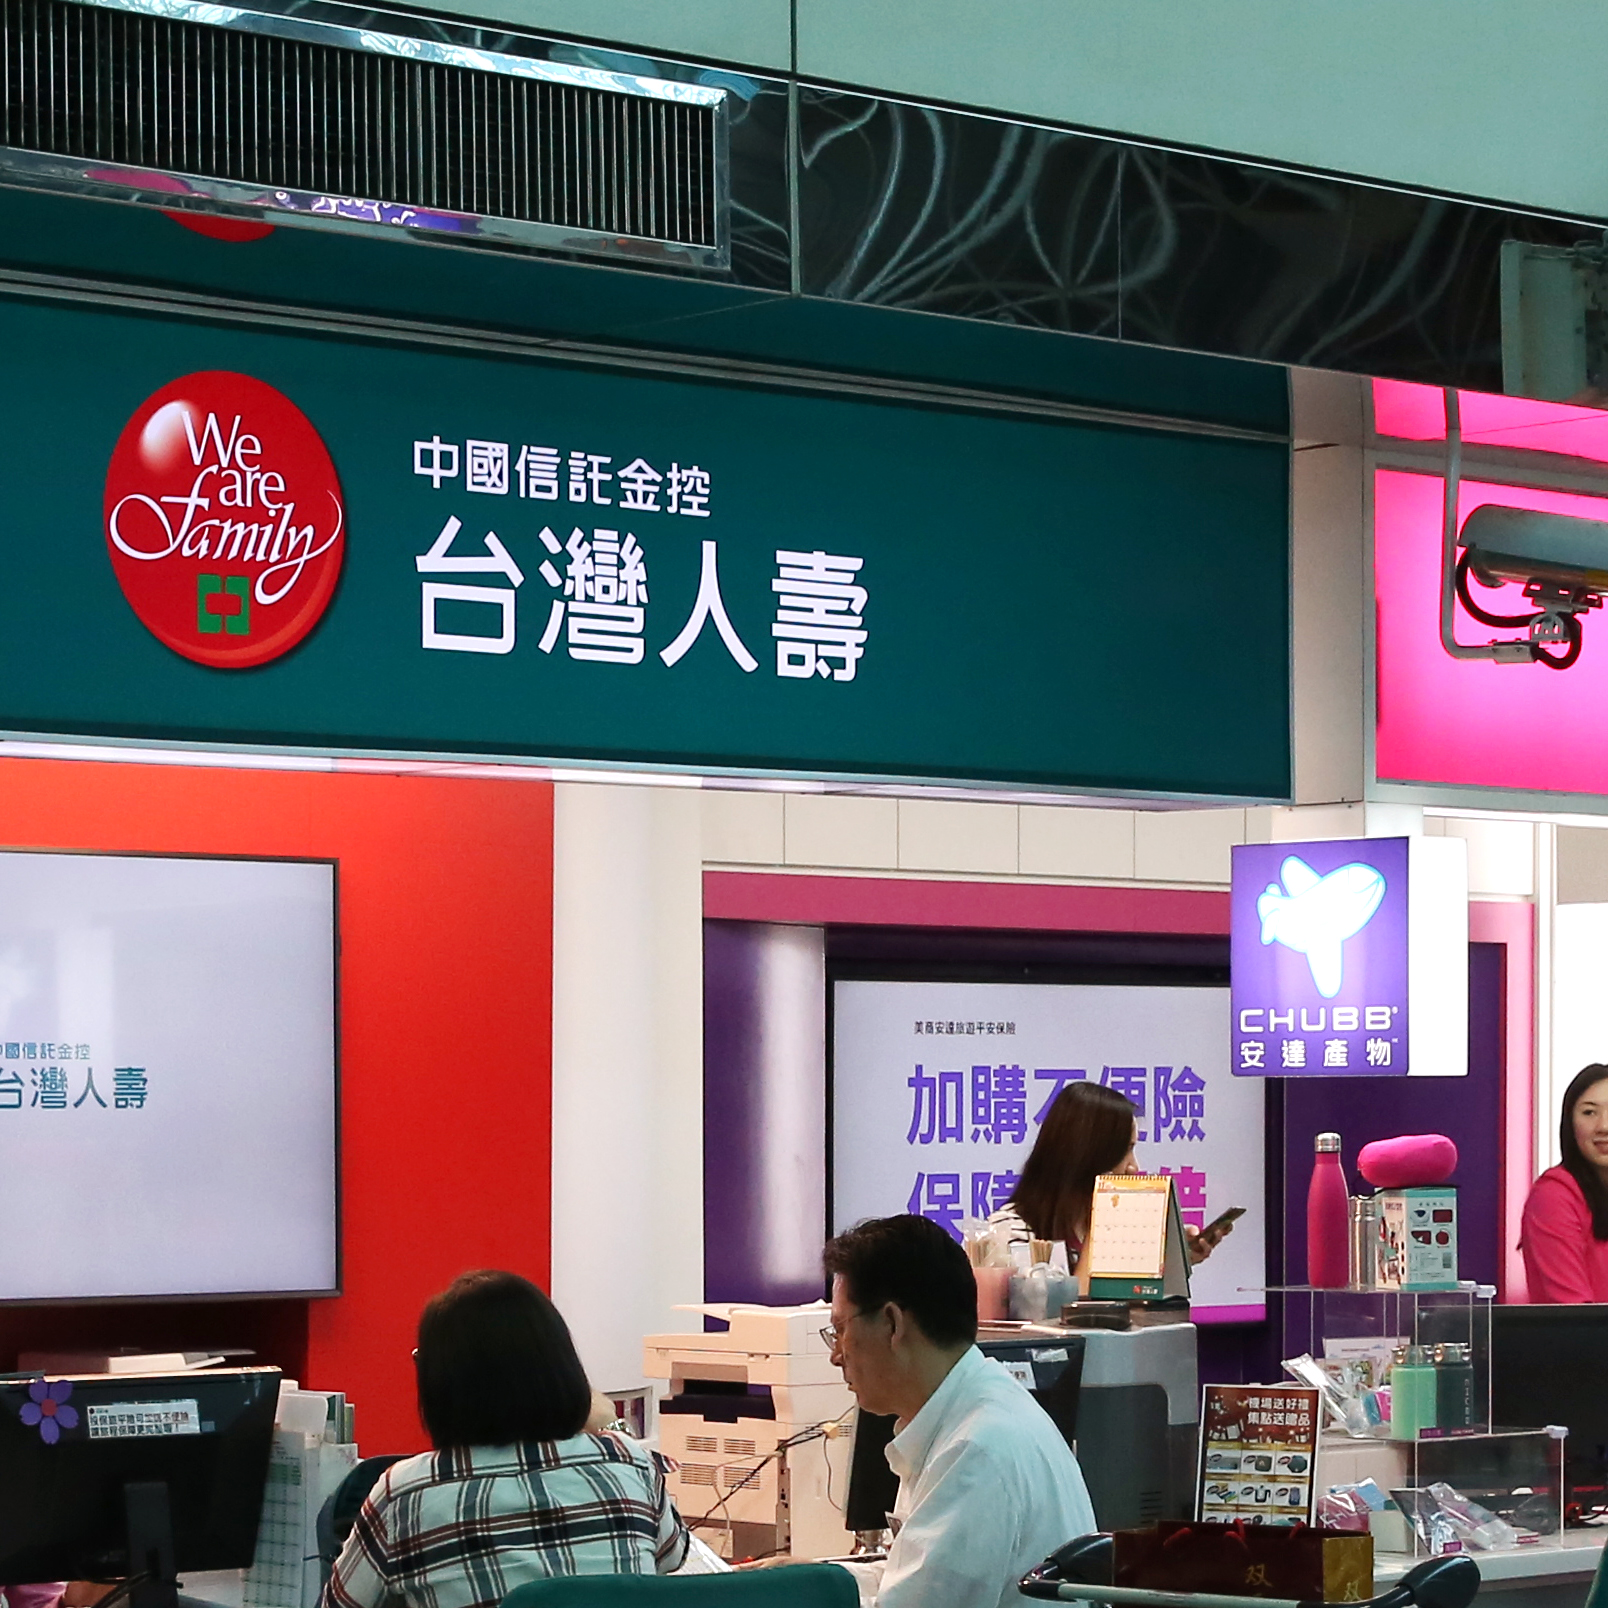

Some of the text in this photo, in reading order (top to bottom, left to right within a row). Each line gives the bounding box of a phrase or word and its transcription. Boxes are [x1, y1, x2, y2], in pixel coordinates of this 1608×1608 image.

[181, 412, 262, 473] We
[219, 467, 285, 509] are
[412, 435, 712, 518] 中國信託金控
[414, 515, 869, 682] 台灣人壽
[1239, 1005, 1396, 1033] CHUBB
[1239, 1038, 1393, 1069] 安達產物
